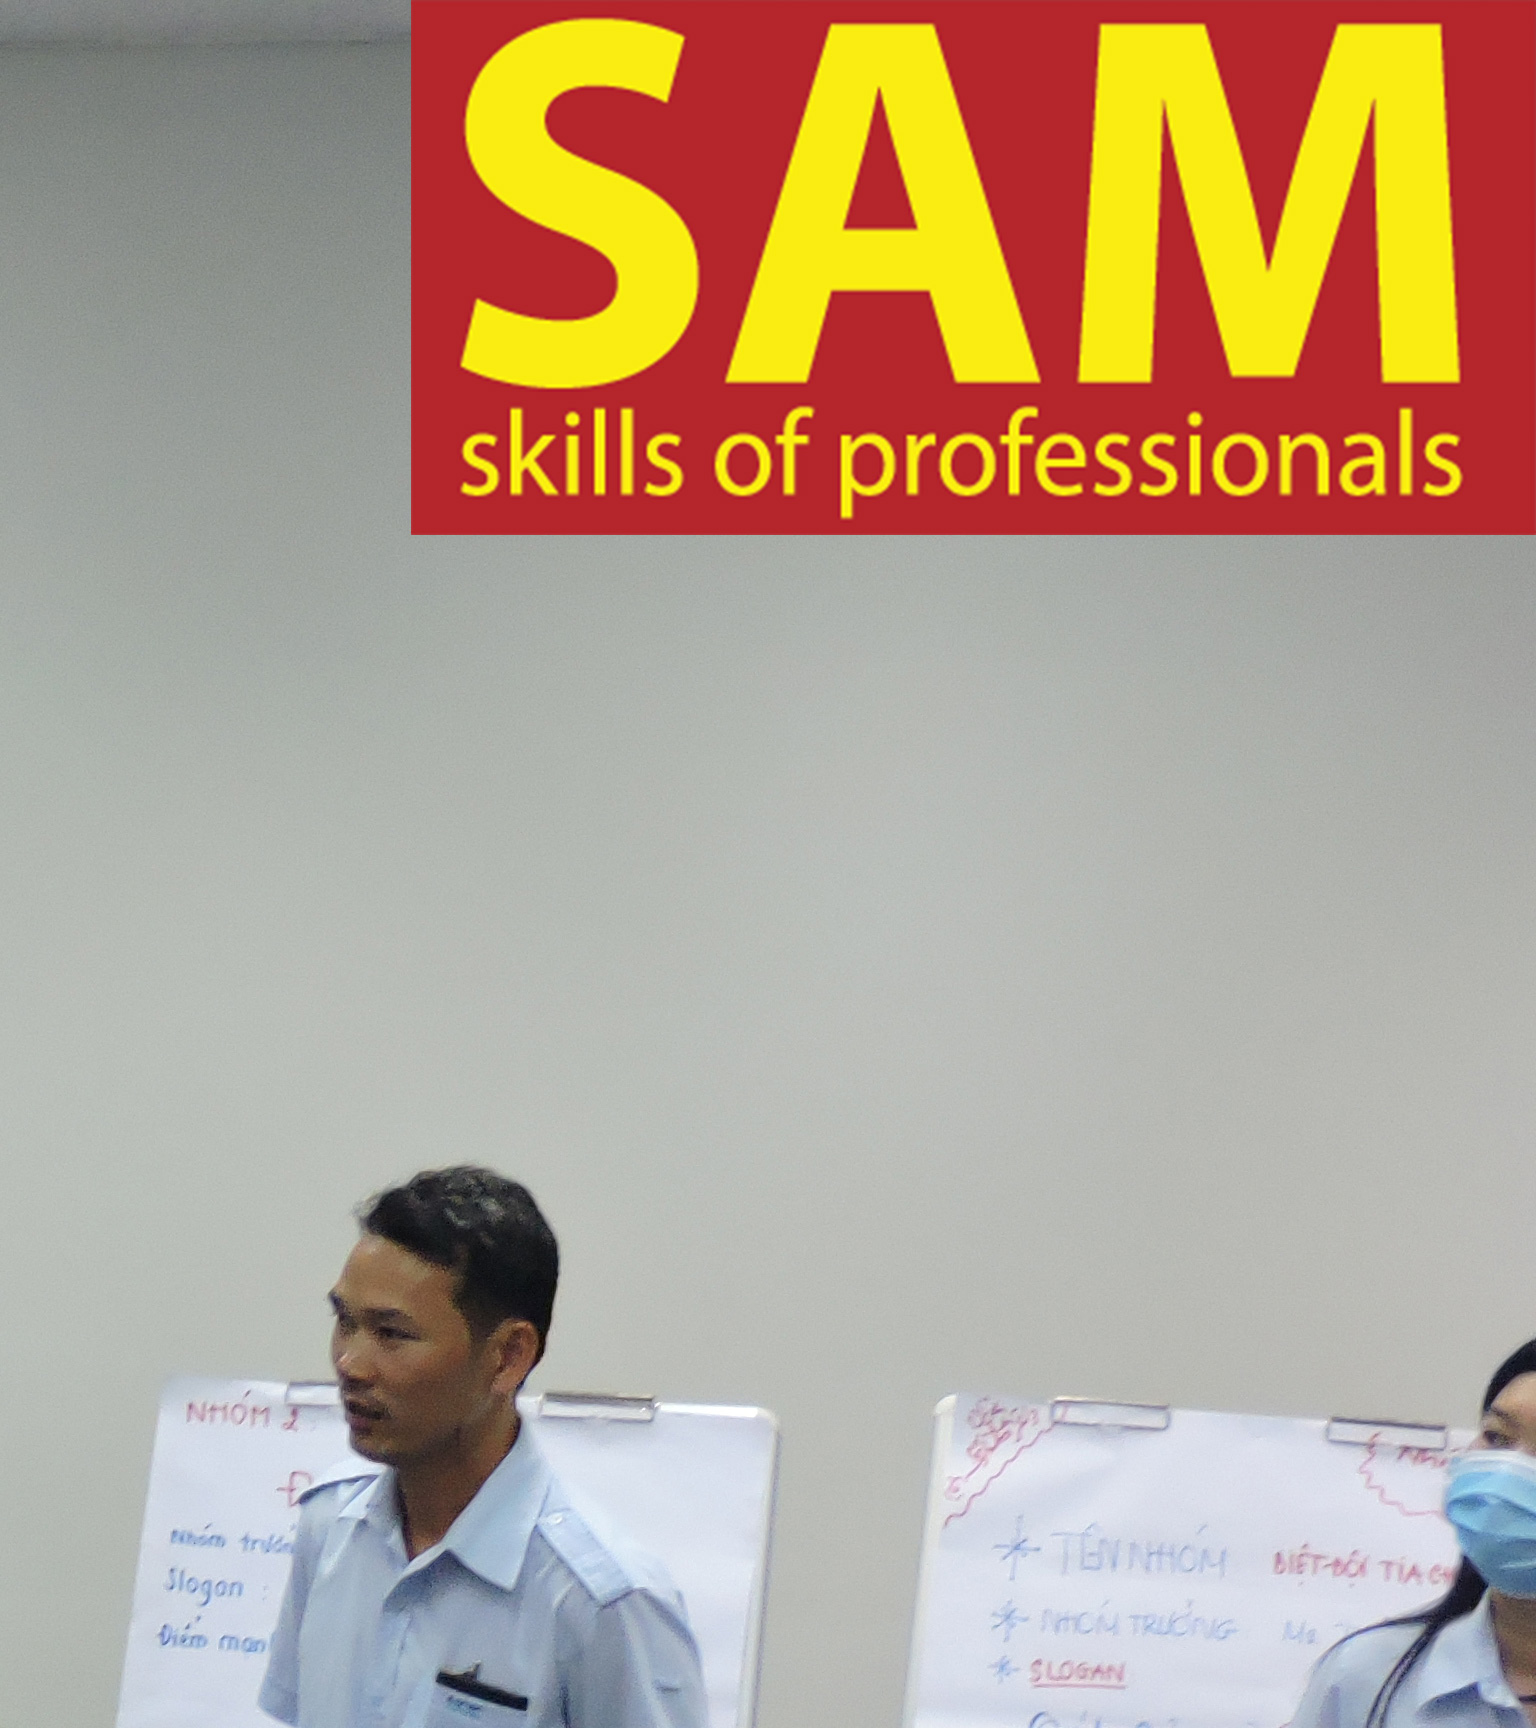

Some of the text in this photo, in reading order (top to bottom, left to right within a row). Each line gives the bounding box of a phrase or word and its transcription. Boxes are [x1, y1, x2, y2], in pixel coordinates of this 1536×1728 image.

[186, 1389, 270, 1428] NHÓM
[1050, 1521, 1120, 1576] TÊN
[1128, 1523, 1229, 1579] NHÓM
[165, 1567, 245, 1607] Slogan
[1028, 1657, 1127, 1684] SLOGAN
